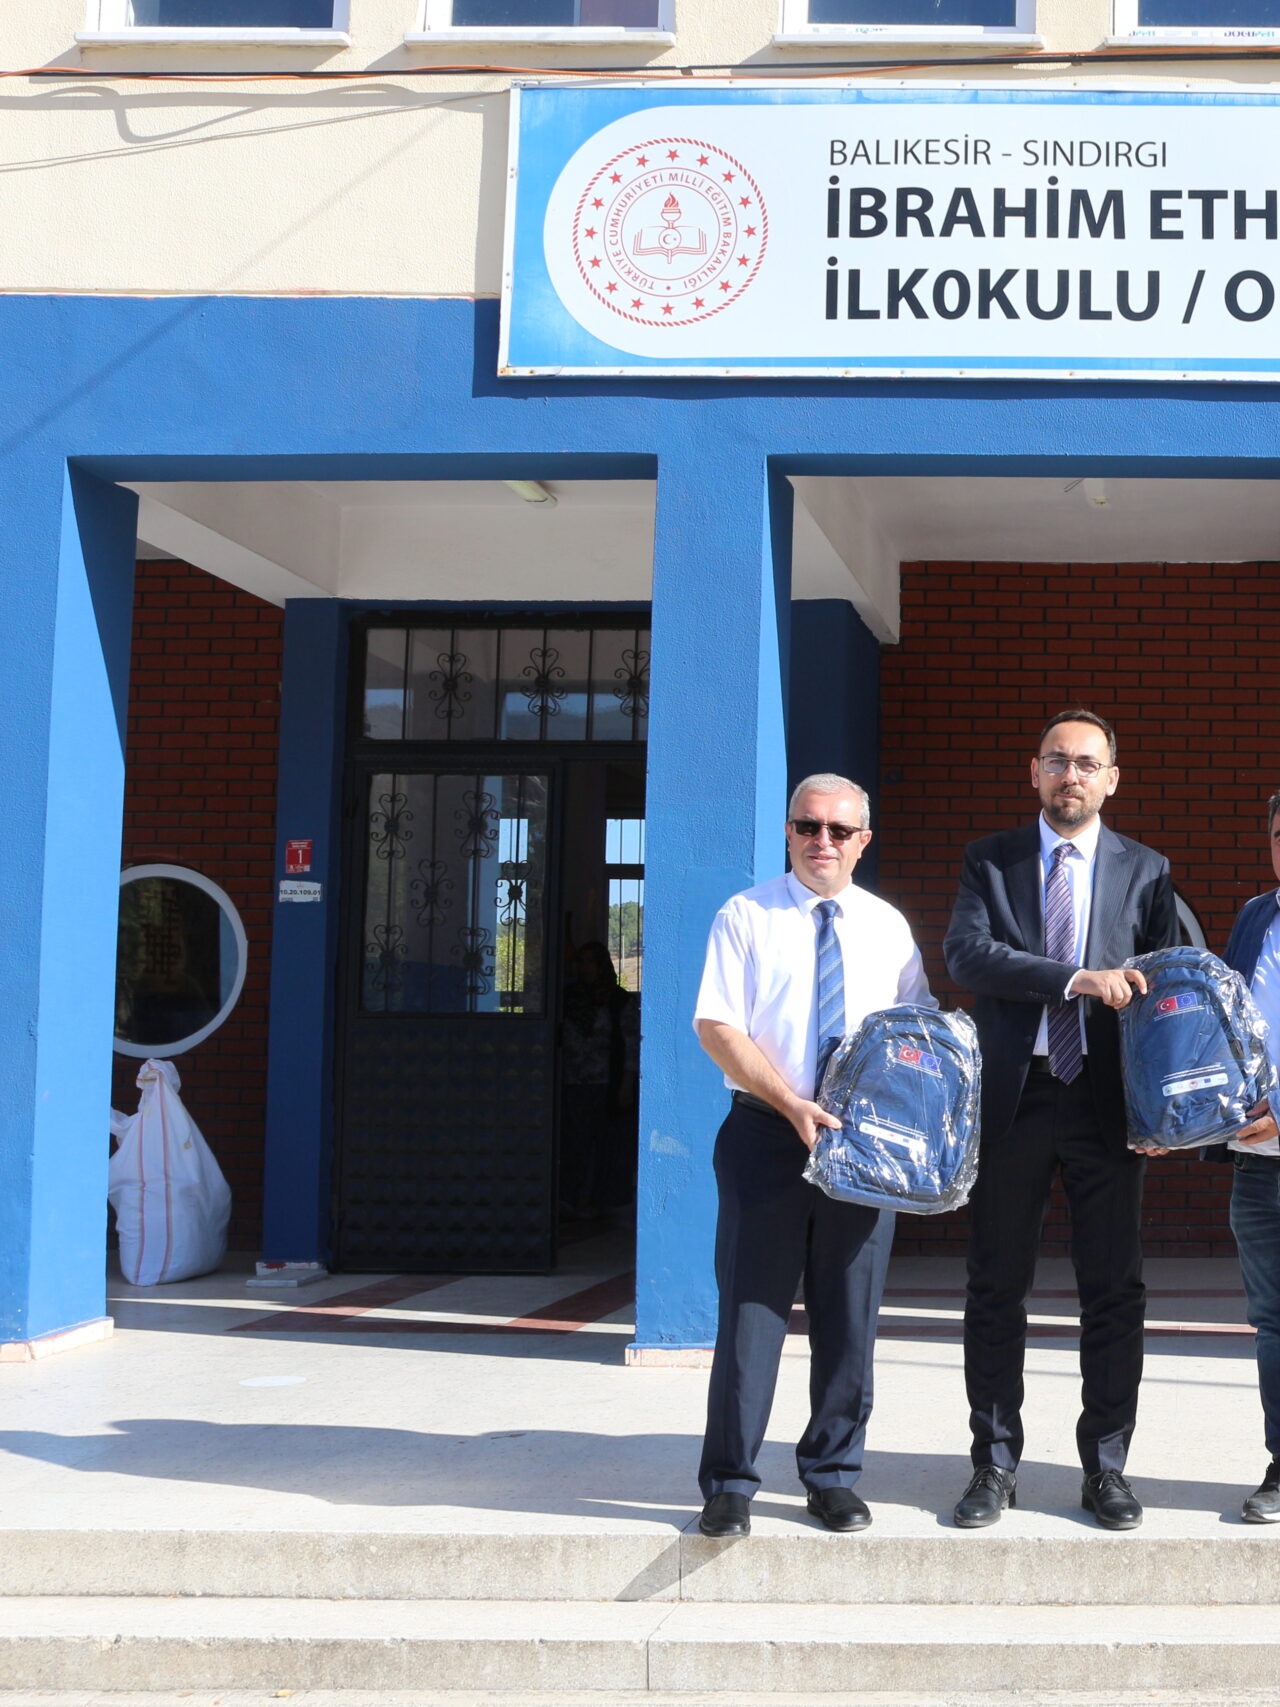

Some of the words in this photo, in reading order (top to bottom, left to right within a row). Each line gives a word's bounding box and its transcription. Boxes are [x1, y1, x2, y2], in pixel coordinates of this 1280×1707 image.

[829, 133, 991, 166] BALIKESİR
[1023, 139, 1167, 168] SINDIRGI
[669, 172, 704, 188] MİLLİ
[609, 172, 663, 246] CUMHURİYETİ
[704, 185, 732, 227] EĞİTİM
[826, 174, 1126, 240] İBRAHİM
[612, 250, 655, 290] TÜRKİYE
[683, 231, 732, 289] BAKANLIĞI
[1181, 269, 1206, 324] /
